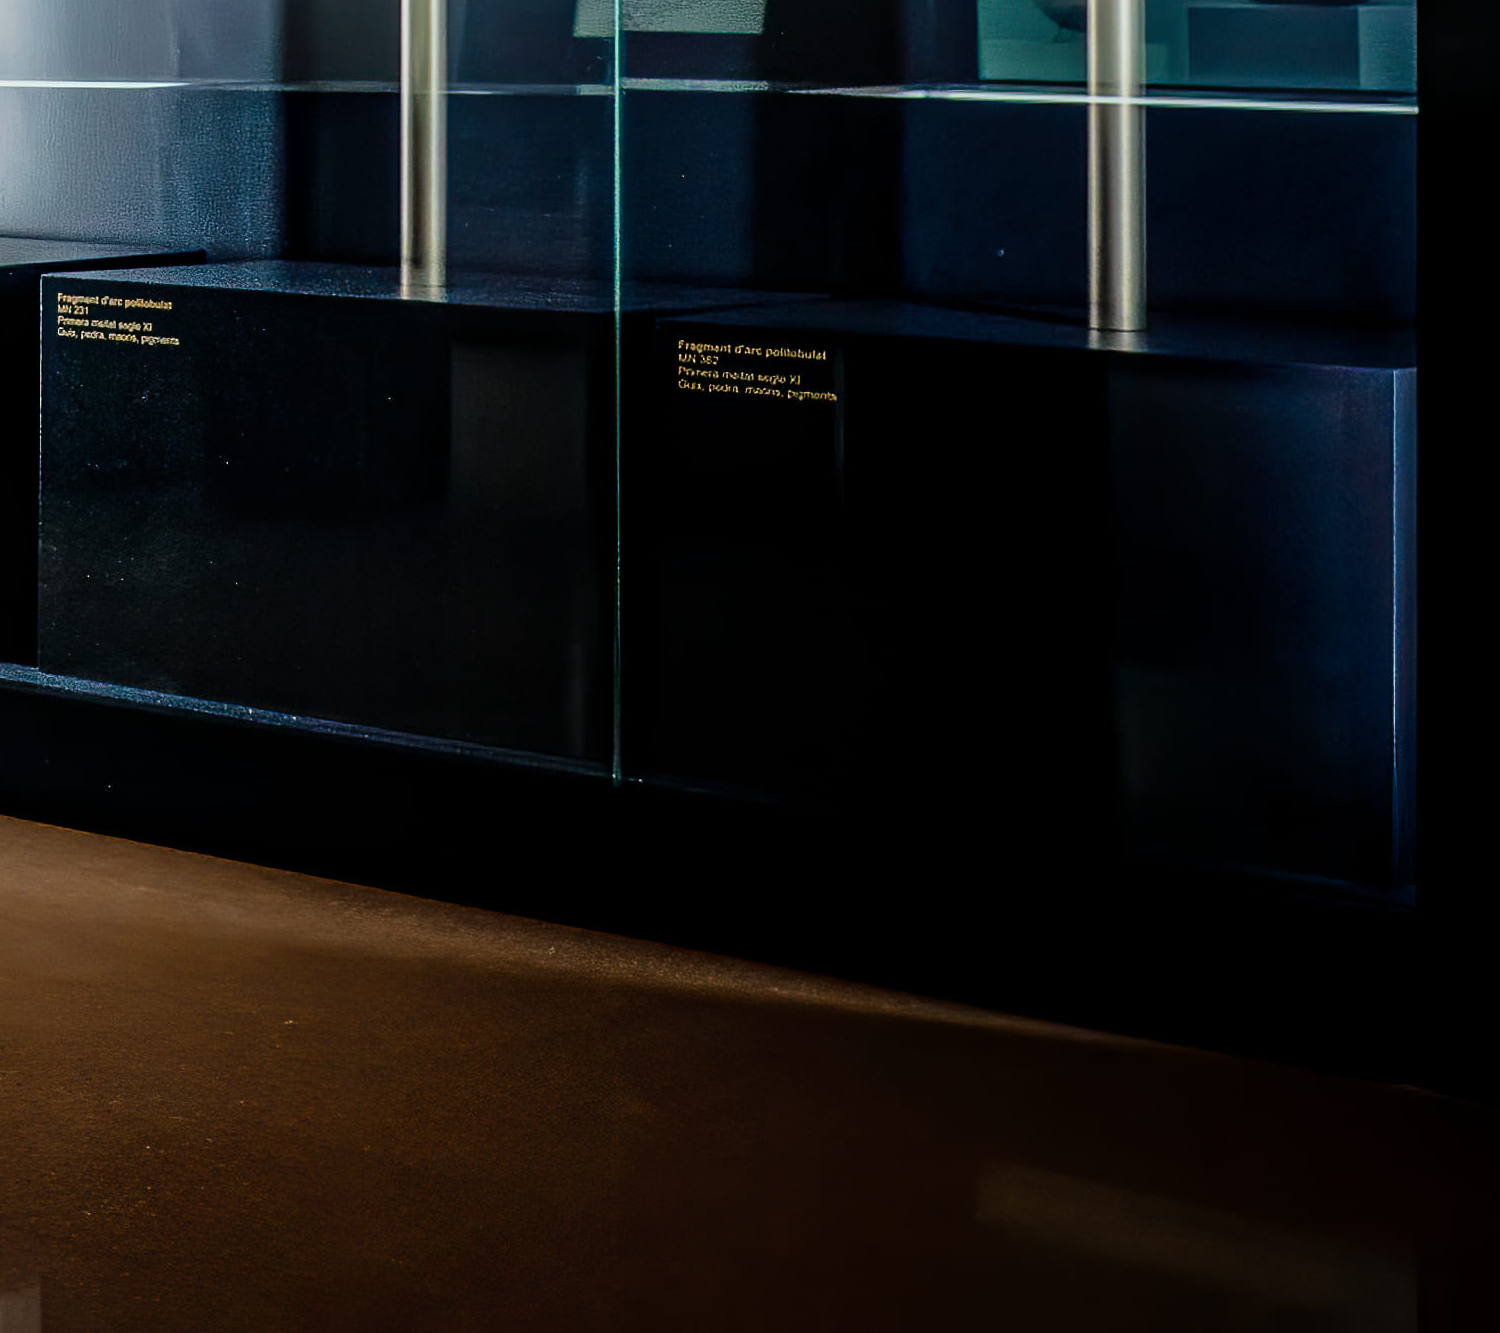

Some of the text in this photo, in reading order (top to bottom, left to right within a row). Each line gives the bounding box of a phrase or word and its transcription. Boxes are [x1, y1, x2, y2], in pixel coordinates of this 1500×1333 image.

[57, 292, 99, 305] Fragment
[100, 296, 123, 307] d'arc
[57, 315, 90, 326] Primera
[678, 339, 732, 354] Fragment
[734, 344, 763, 356] d'arc
